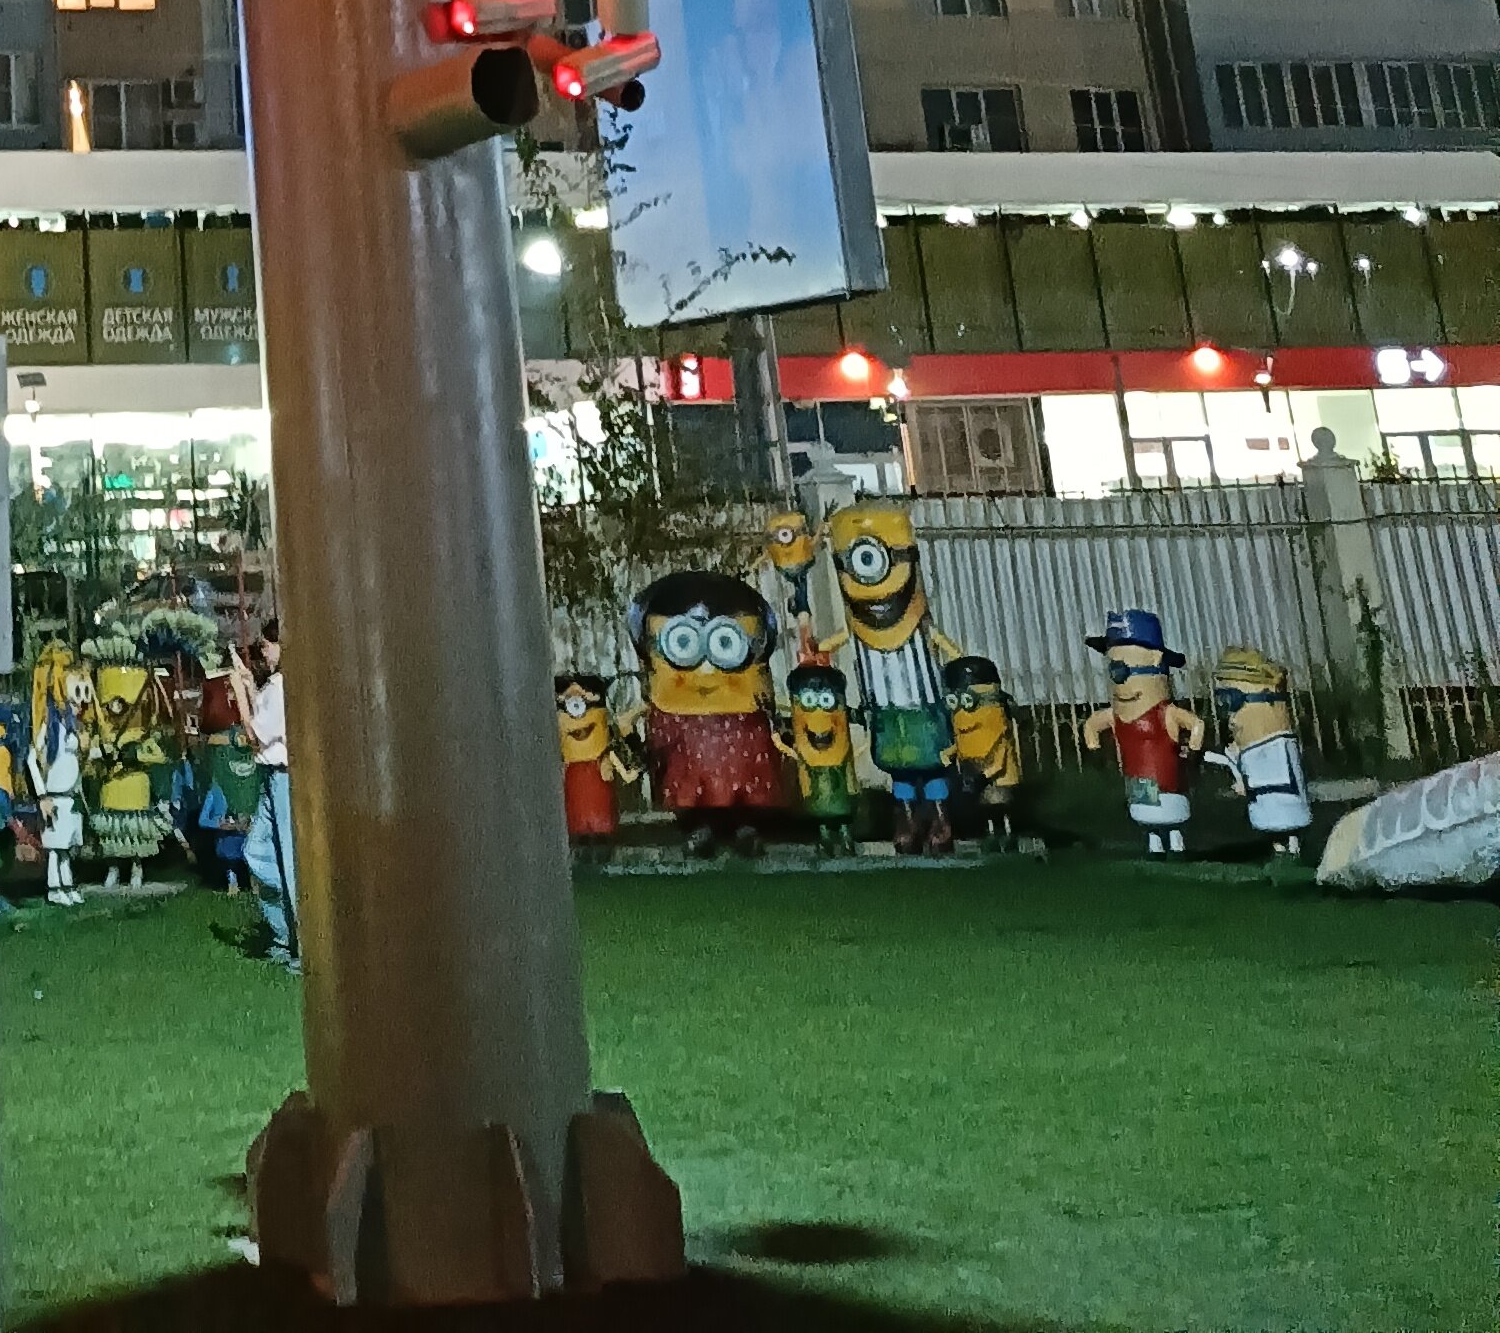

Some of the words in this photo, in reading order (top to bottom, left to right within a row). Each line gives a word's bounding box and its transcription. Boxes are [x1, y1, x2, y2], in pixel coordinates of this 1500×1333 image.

[1, 308, 78, 327] ЖЕНСКАЯ
[102, 307, 173, 325] ДЕТСКАЯ
[102, 325, 173, 343] ОДЕЖДА
